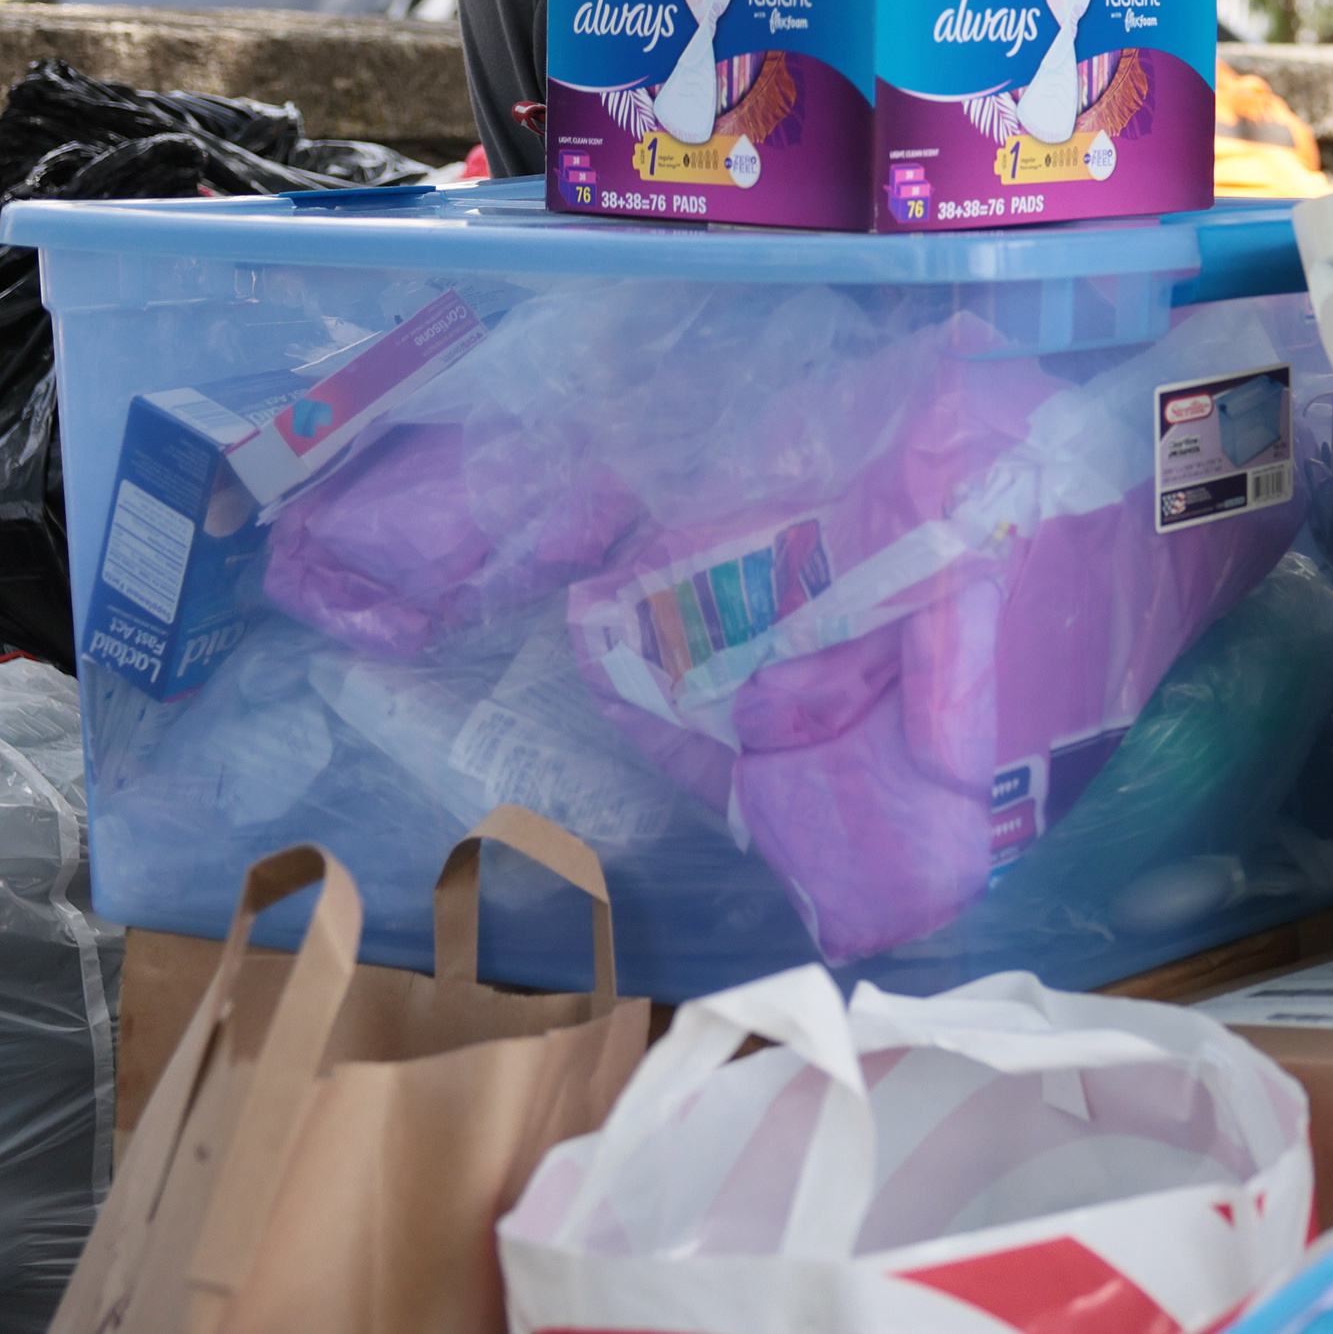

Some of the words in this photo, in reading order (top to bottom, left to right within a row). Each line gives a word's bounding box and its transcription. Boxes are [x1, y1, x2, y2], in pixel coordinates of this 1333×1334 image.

[646, 137, 659, 176] 1
[732, 154, 757, 165] ZERO
[1007, 141, 1020, 180] 1
[1091, 149, 1114, 159] ZERO
[1091, 157, 1113, 167] FEEL
[732, 164, 757, 174] FEEL
[575, 186, 592, 204] 76
[601, 190, 667, 213] 38+38=76
[673, 195, 708, 215] PADS
[907, 200, 924, 219] 76
[938, 197, 1005, 220] 38+38=76
[1011, 195, 1044, 215] PADS
[413, 305, 468, 347] Cortisone
[108, 617, 133, 638] Act
[133, 628, 167, 655] Fast
[89, 629, 163, 684] Lactaid
